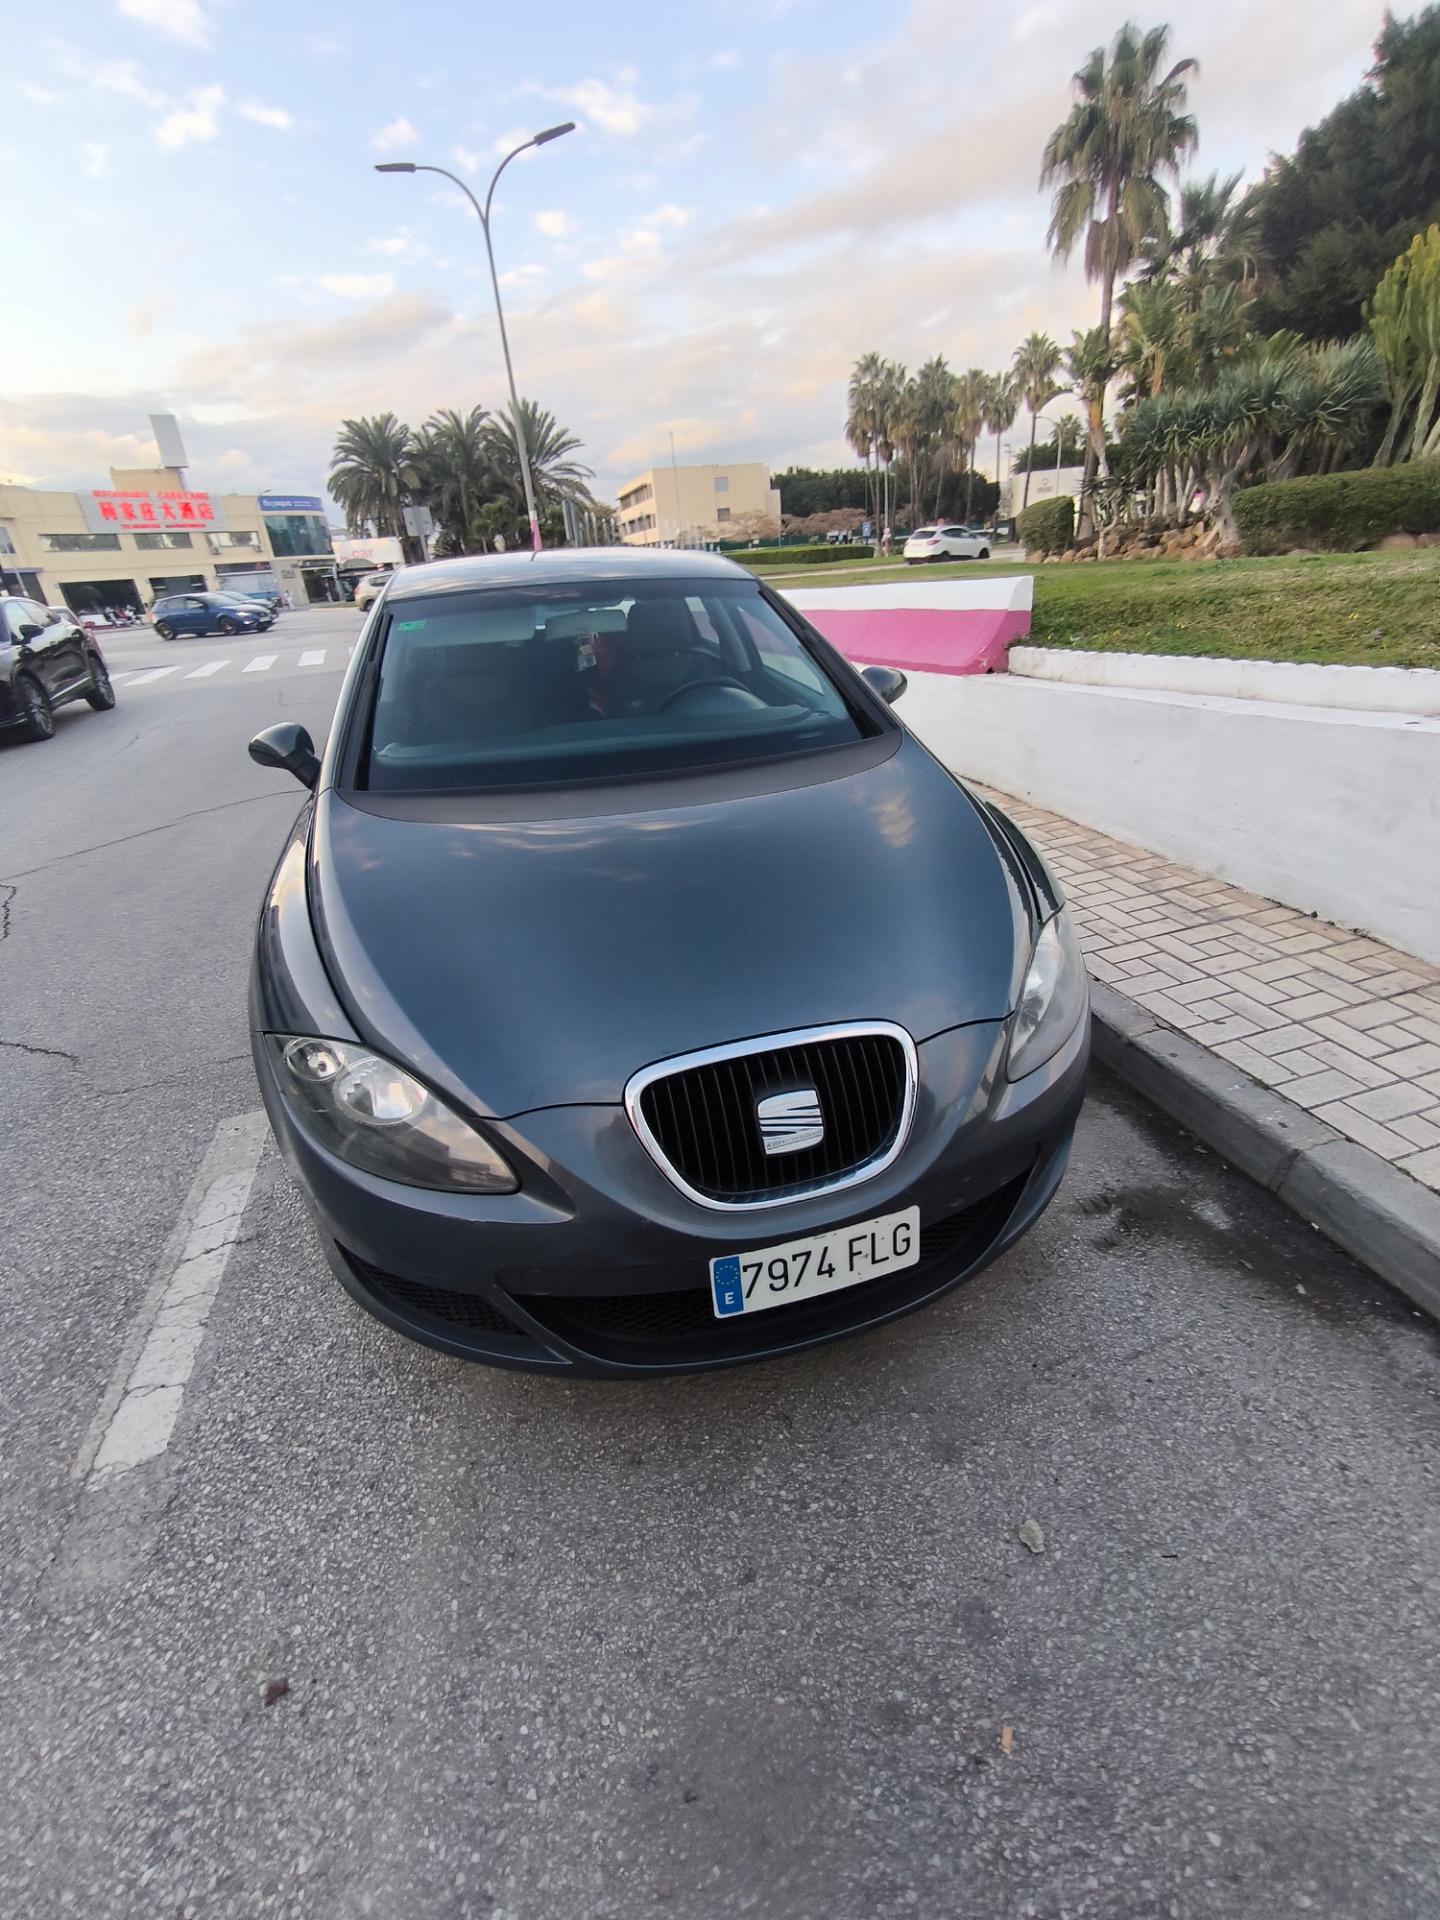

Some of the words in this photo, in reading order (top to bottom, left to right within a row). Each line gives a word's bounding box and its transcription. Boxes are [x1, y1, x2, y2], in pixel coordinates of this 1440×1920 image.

[742, 1246, 836, 1299] 7974
[848, 1222, 911, 1272] FLG
[724, 1291, 735, 1305] E
